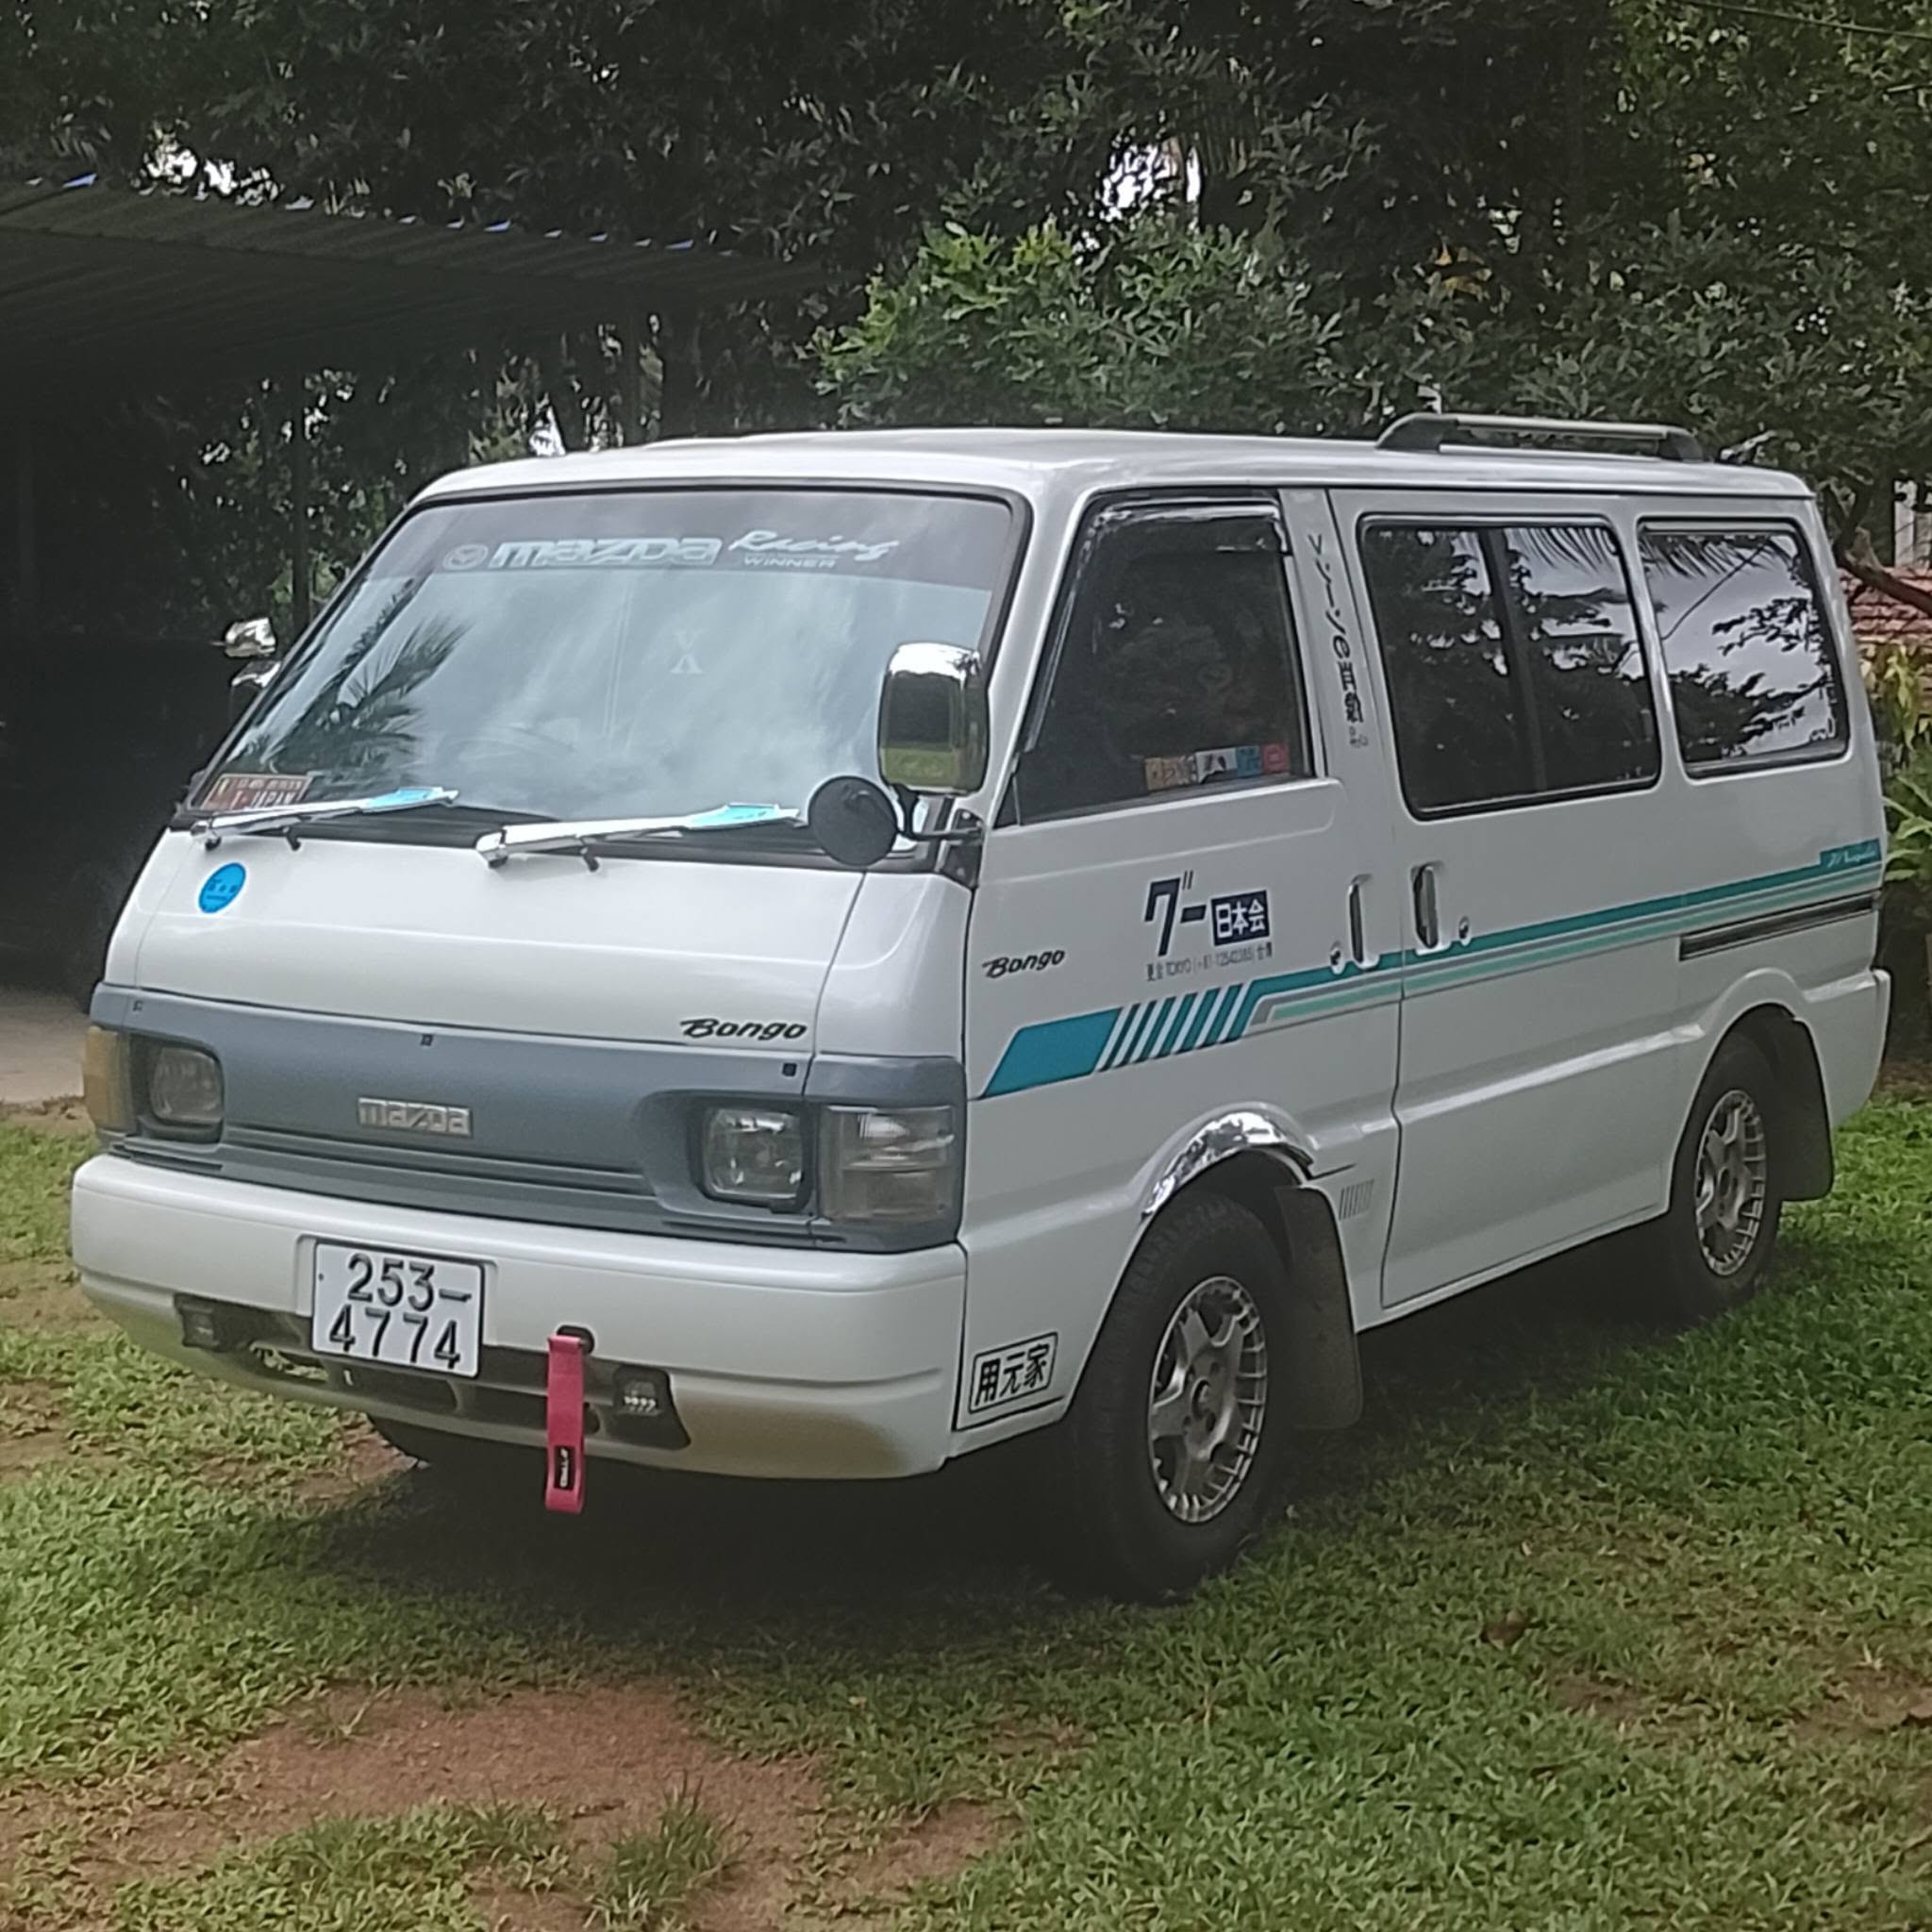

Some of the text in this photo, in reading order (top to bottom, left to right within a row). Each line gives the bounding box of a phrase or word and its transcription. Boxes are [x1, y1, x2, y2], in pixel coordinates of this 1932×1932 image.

[728, 529, 900, 562] Racing
[744, 553, 838, 569] WINNER
[1215, 898, 1266, 939] 日本会
[981, 949, 1066, 978] Bongo
[679, 1018, 808, 1041] Bongo
[358, 1097, 471, 1135] mazda
[328, 1303, 461, 1370] 4774
